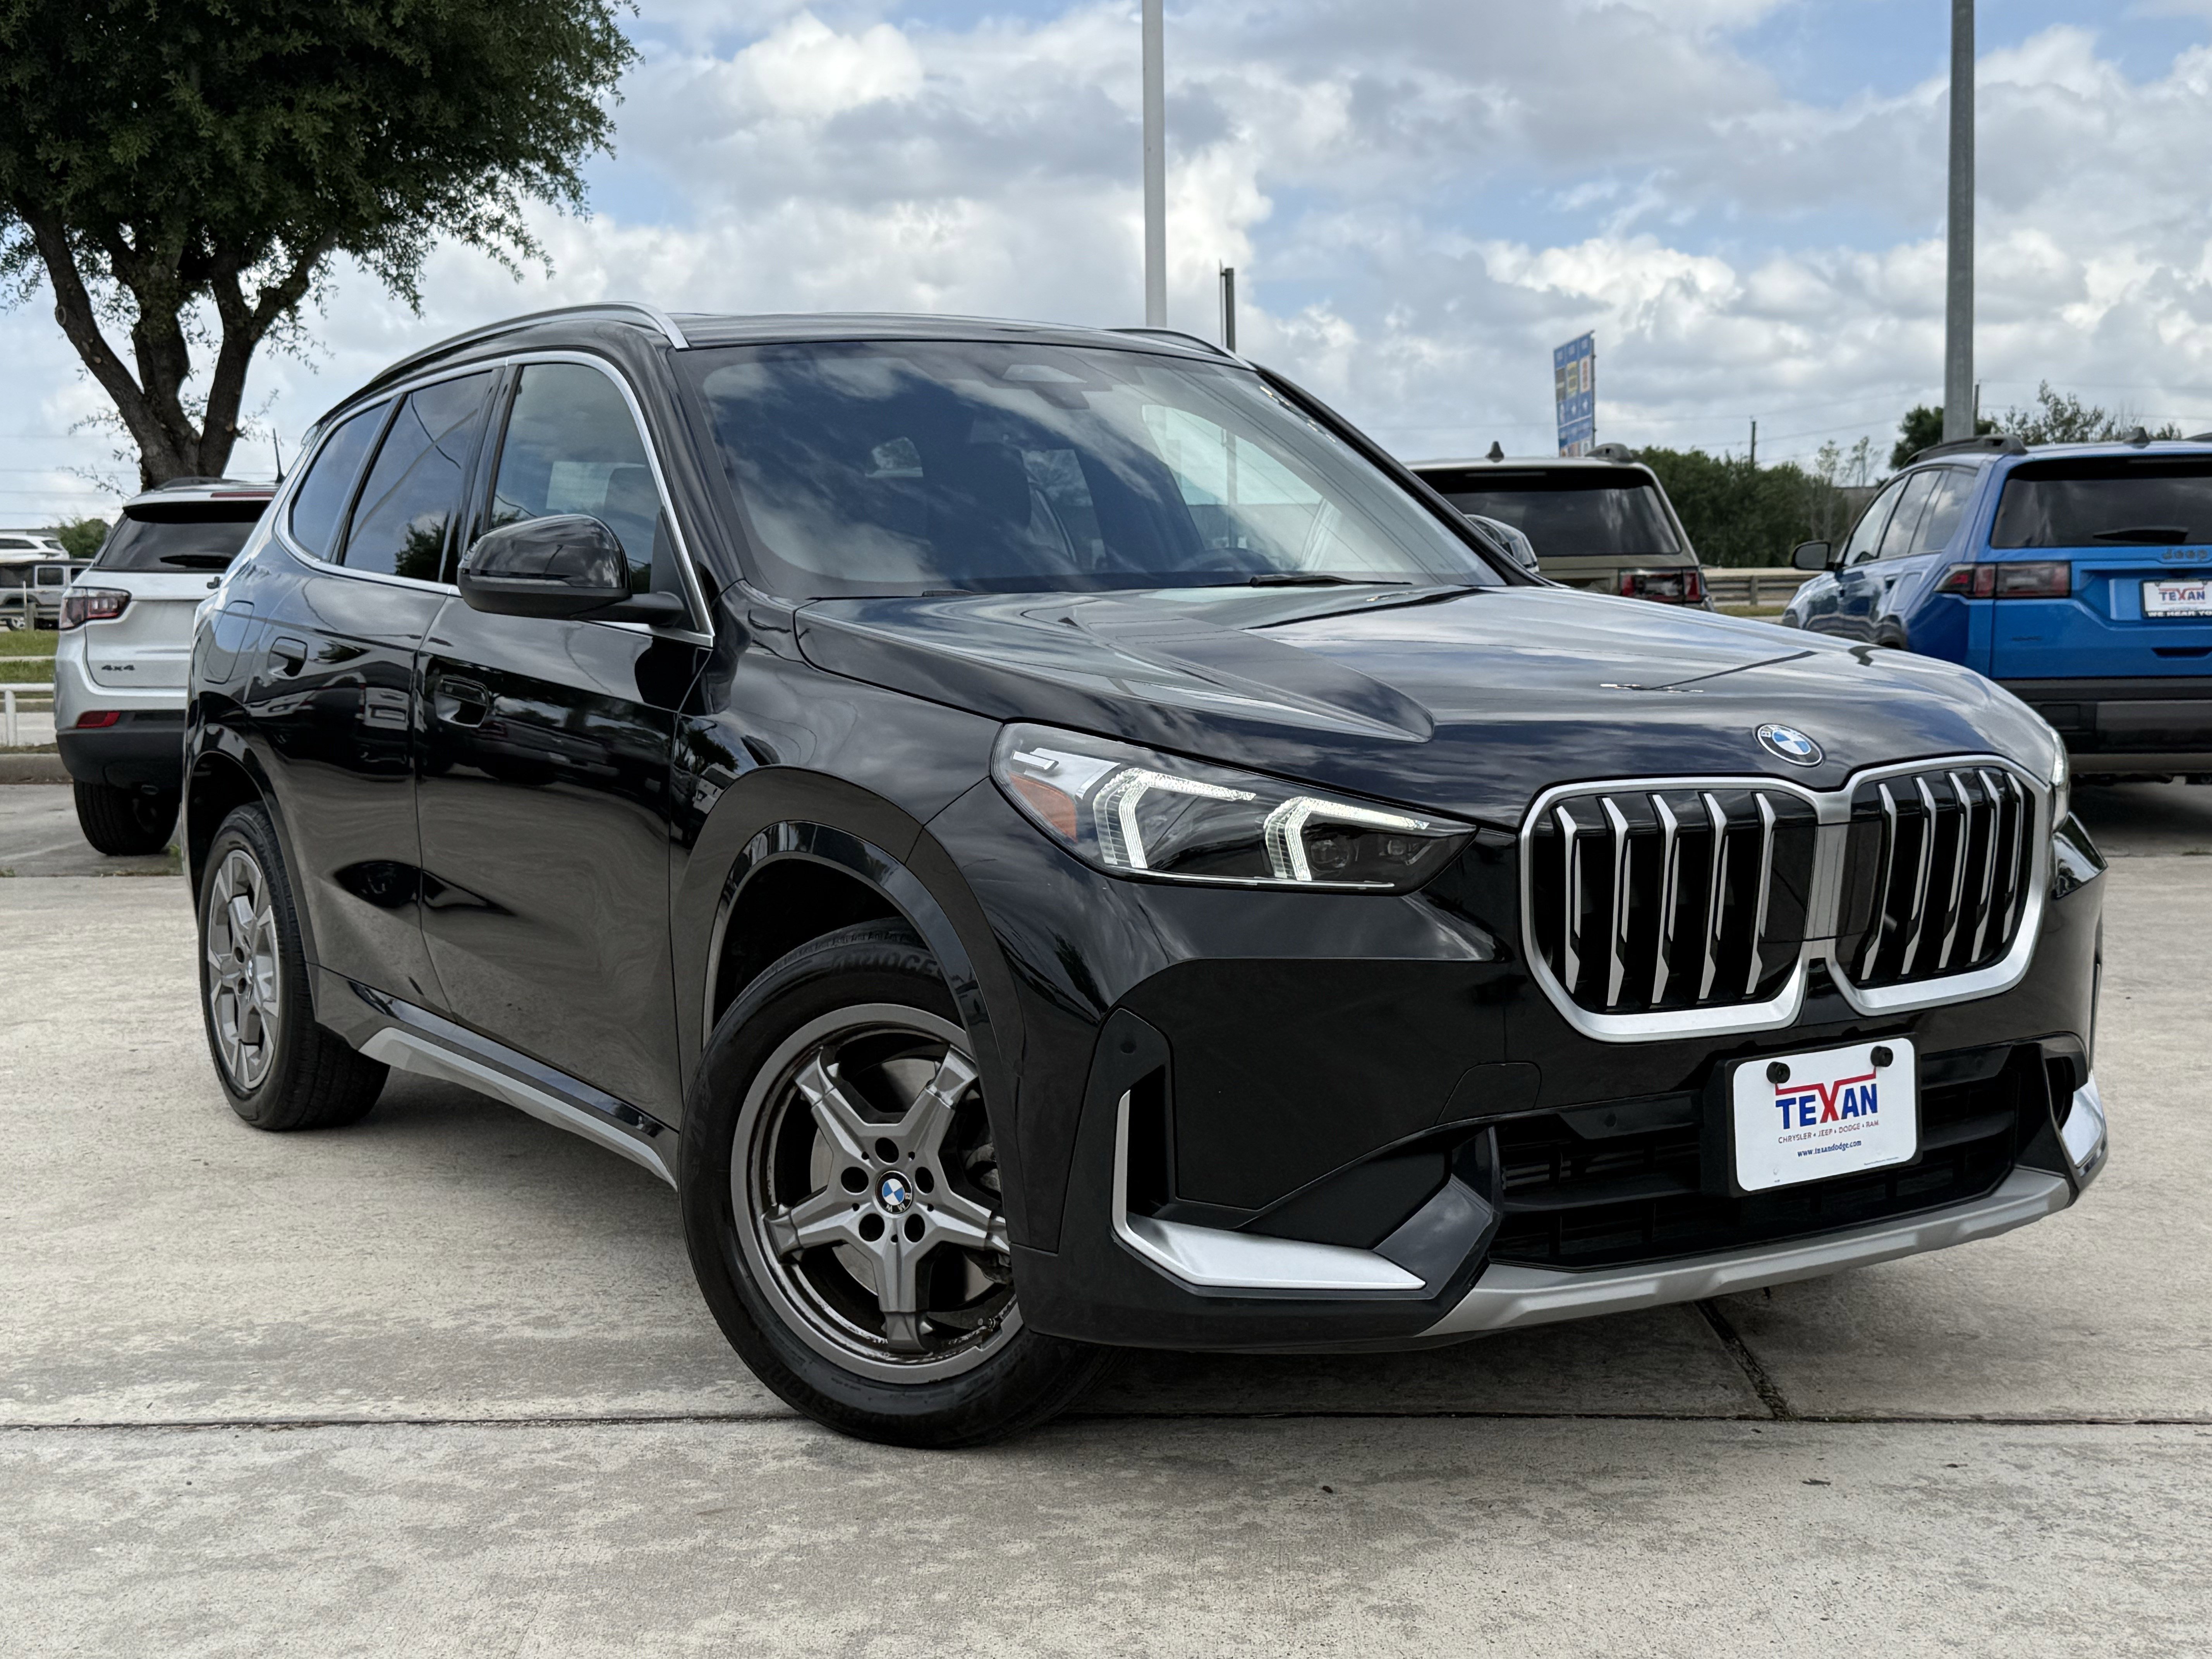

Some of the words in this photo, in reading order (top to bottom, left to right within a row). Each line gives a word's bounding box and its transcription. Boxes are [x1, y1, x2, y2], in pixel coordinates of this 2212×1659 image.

[2161, 548, 2208, 560] Jeep
[2159, 589, 2205, 601] TEXAN
[1776, 1081, 1878, 1130] TEXAN
[1778, 1132, 1812, 1144] CHRYSLER
[1818, 1128, 1833, 1137] JEEP
[1839, 1123, 1860, 1133] DODGE
[1865, 1120, 1879, 1128] RAM
